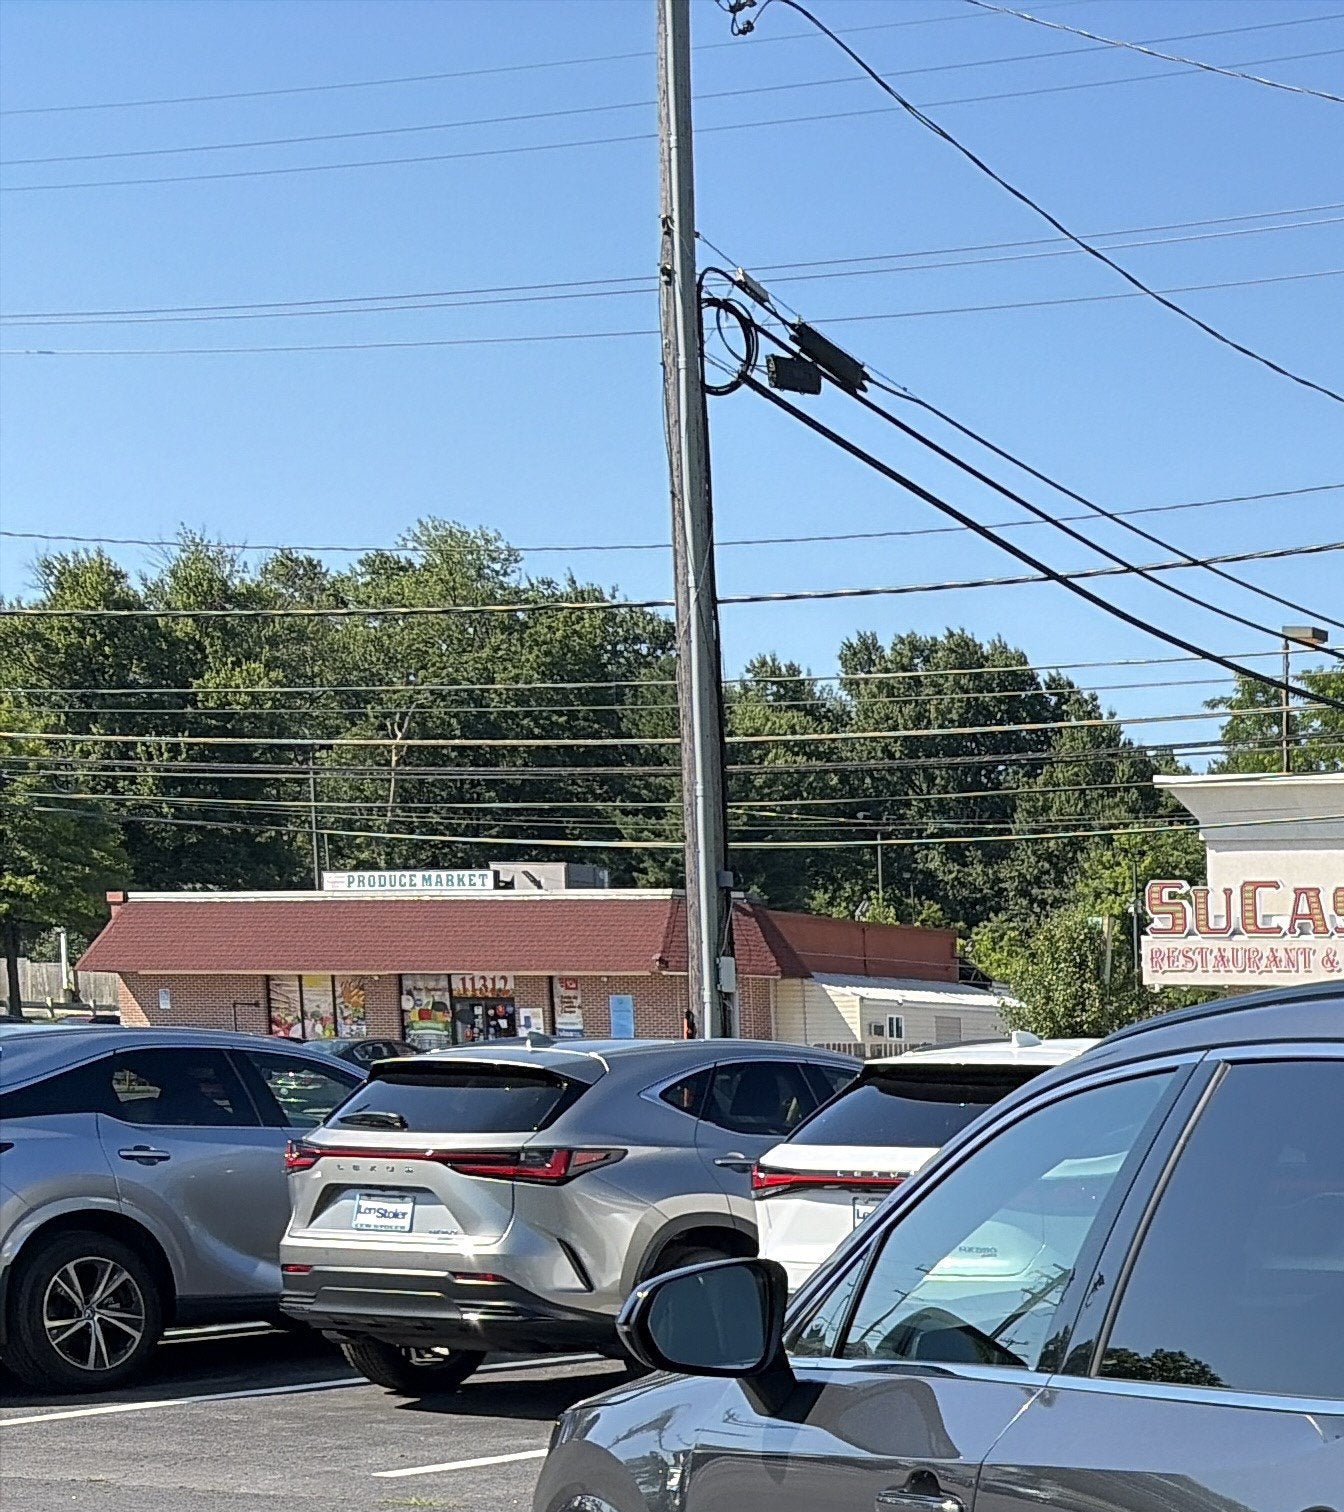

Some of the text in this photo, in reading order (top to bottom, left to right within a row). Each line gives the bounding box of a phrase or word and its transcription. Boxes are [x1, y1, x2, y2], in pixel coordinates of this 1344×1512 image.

[347, 874, 417, 888] PRODUCE
[421, 874, 488, 888] MARKET
[1150, 947, 1316, 971] RESTAURANT
[1322, 947, 1340, 970] &
[460, 975, 509, 996] 11312
